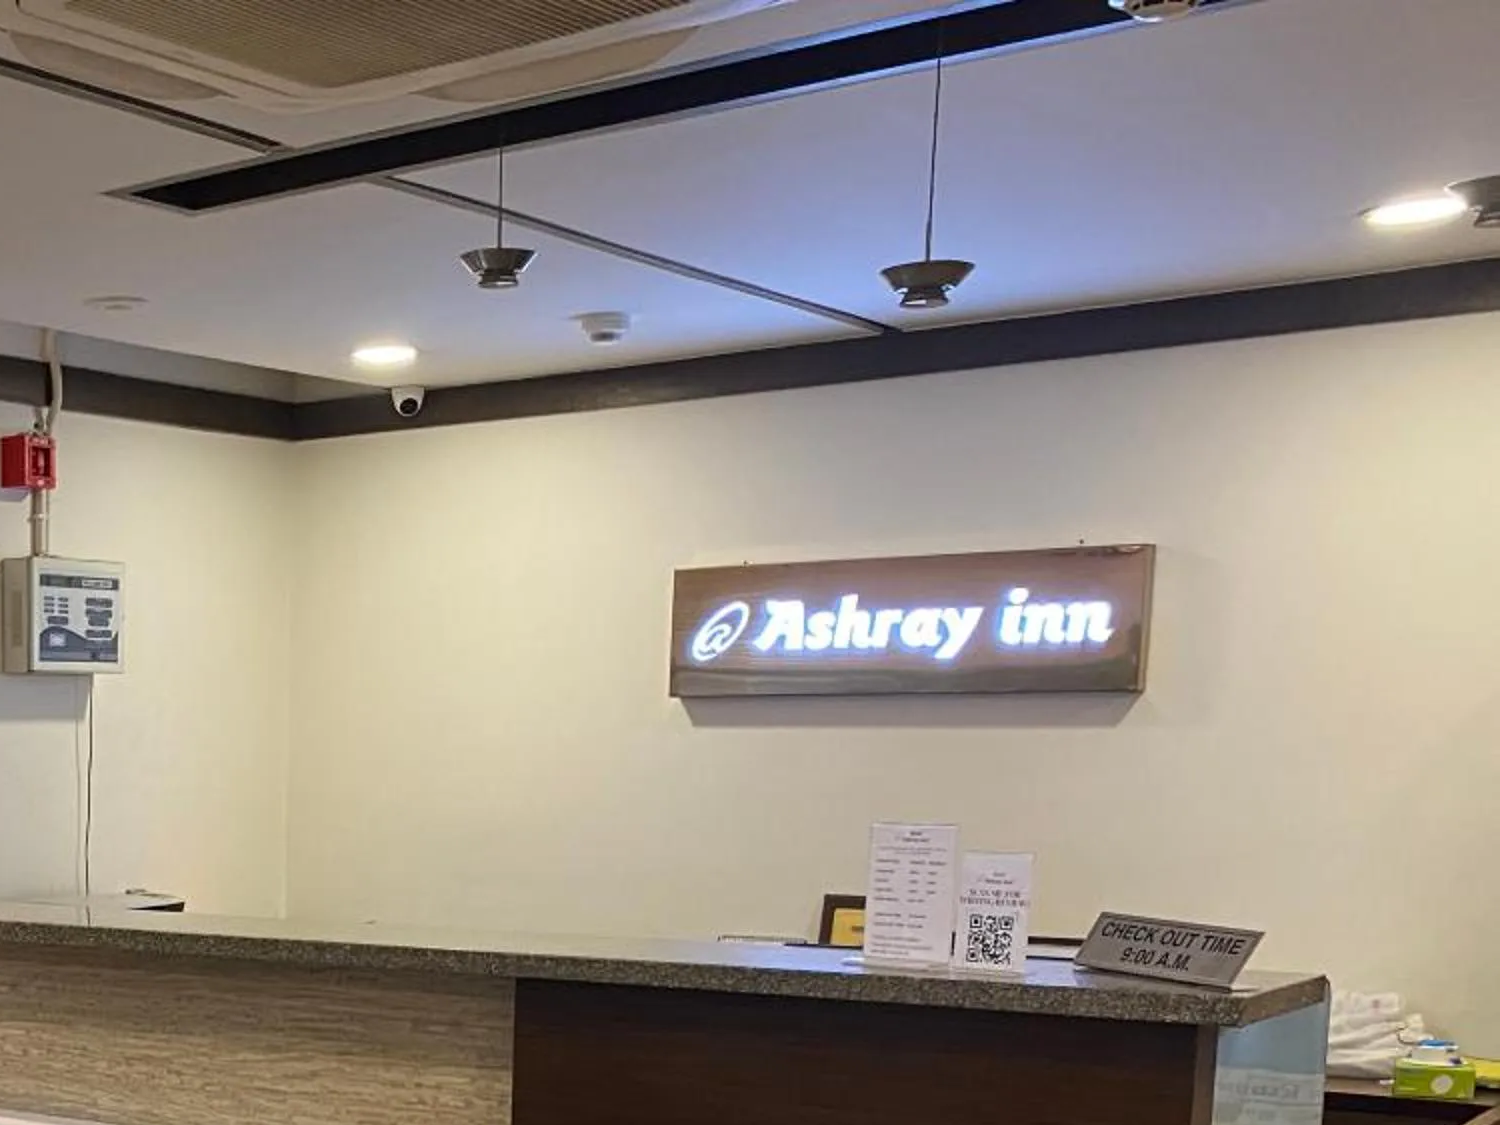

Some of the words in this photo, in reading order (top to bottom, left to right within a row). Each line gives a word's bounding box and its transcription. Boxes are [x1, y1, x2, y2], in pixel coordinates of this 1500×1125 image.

[754, 592, 985, 659] Ashray
[999, 587, 1115, 646] inn
[1101, 921, 1159, 944] CHECK
[1159, 929, 1200, 949] OUT
[1201, 934, 1247, 955] TIME
[1120, 947, 1155, 965] 9:00
[1154, 951, 1190, 971] A.M.
